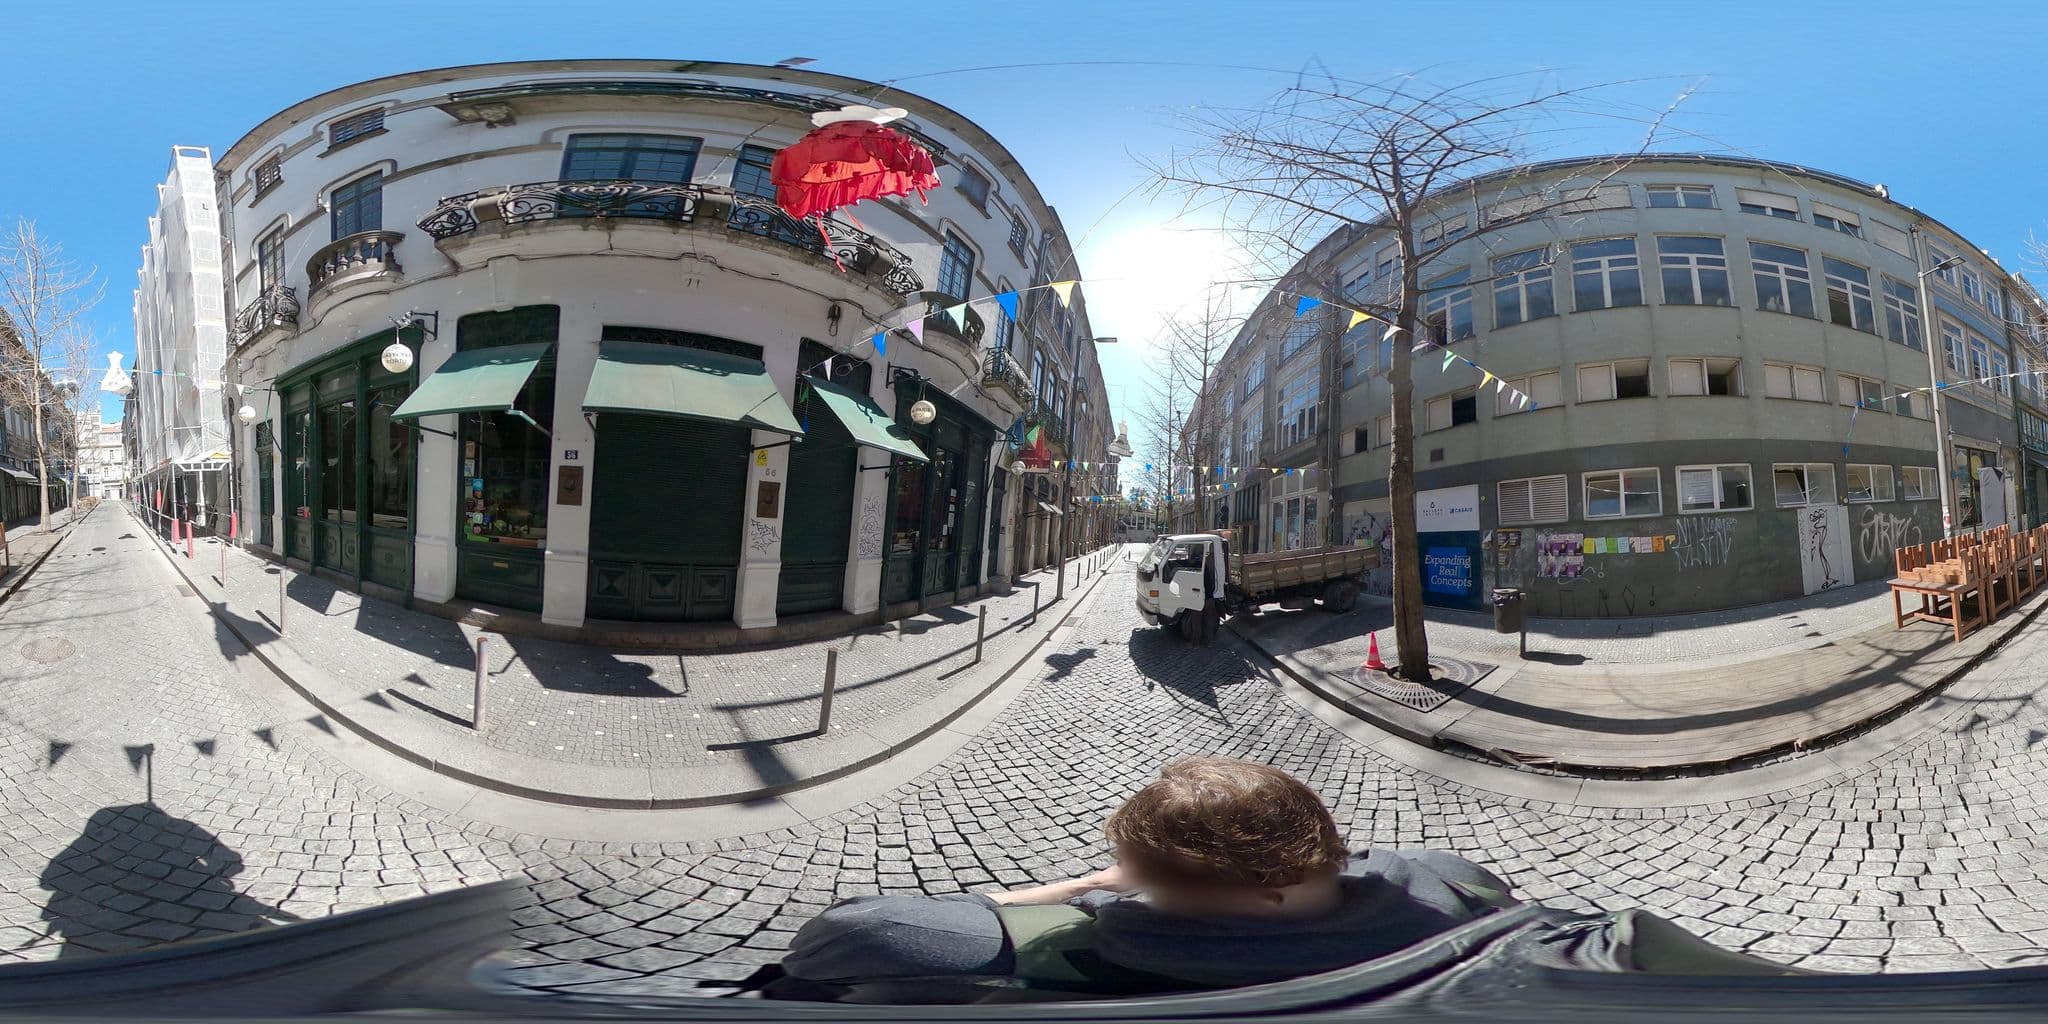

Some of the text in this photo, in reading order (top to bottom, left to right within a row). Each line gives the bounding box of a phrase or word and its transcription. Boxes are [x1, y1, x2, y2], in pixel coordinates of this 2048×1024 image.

[1424, 554, 1471, 569] Expanding
[1439, 565, 1458, 576] Real
[1430, 575, 1473, 589] Concepts
